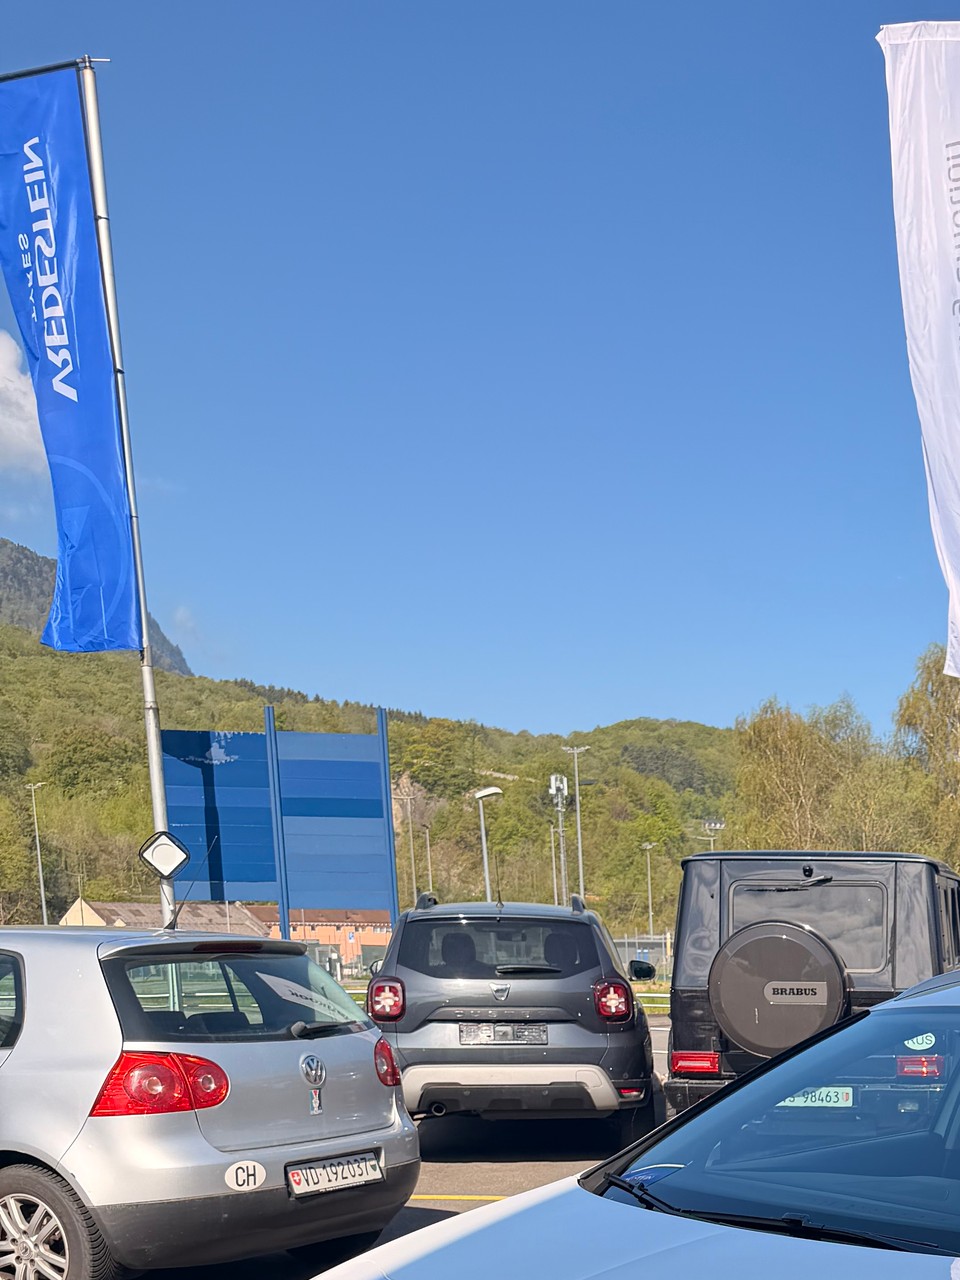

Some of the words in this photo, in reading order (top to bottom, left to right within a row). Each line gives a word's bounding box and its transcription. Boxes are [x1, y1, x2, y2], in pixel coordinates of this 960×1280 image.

[772, 987, 817, 996] BRABUS
[802, 1090, 840, 1104] 98463
[235, 1165, 257, 1187] CH
